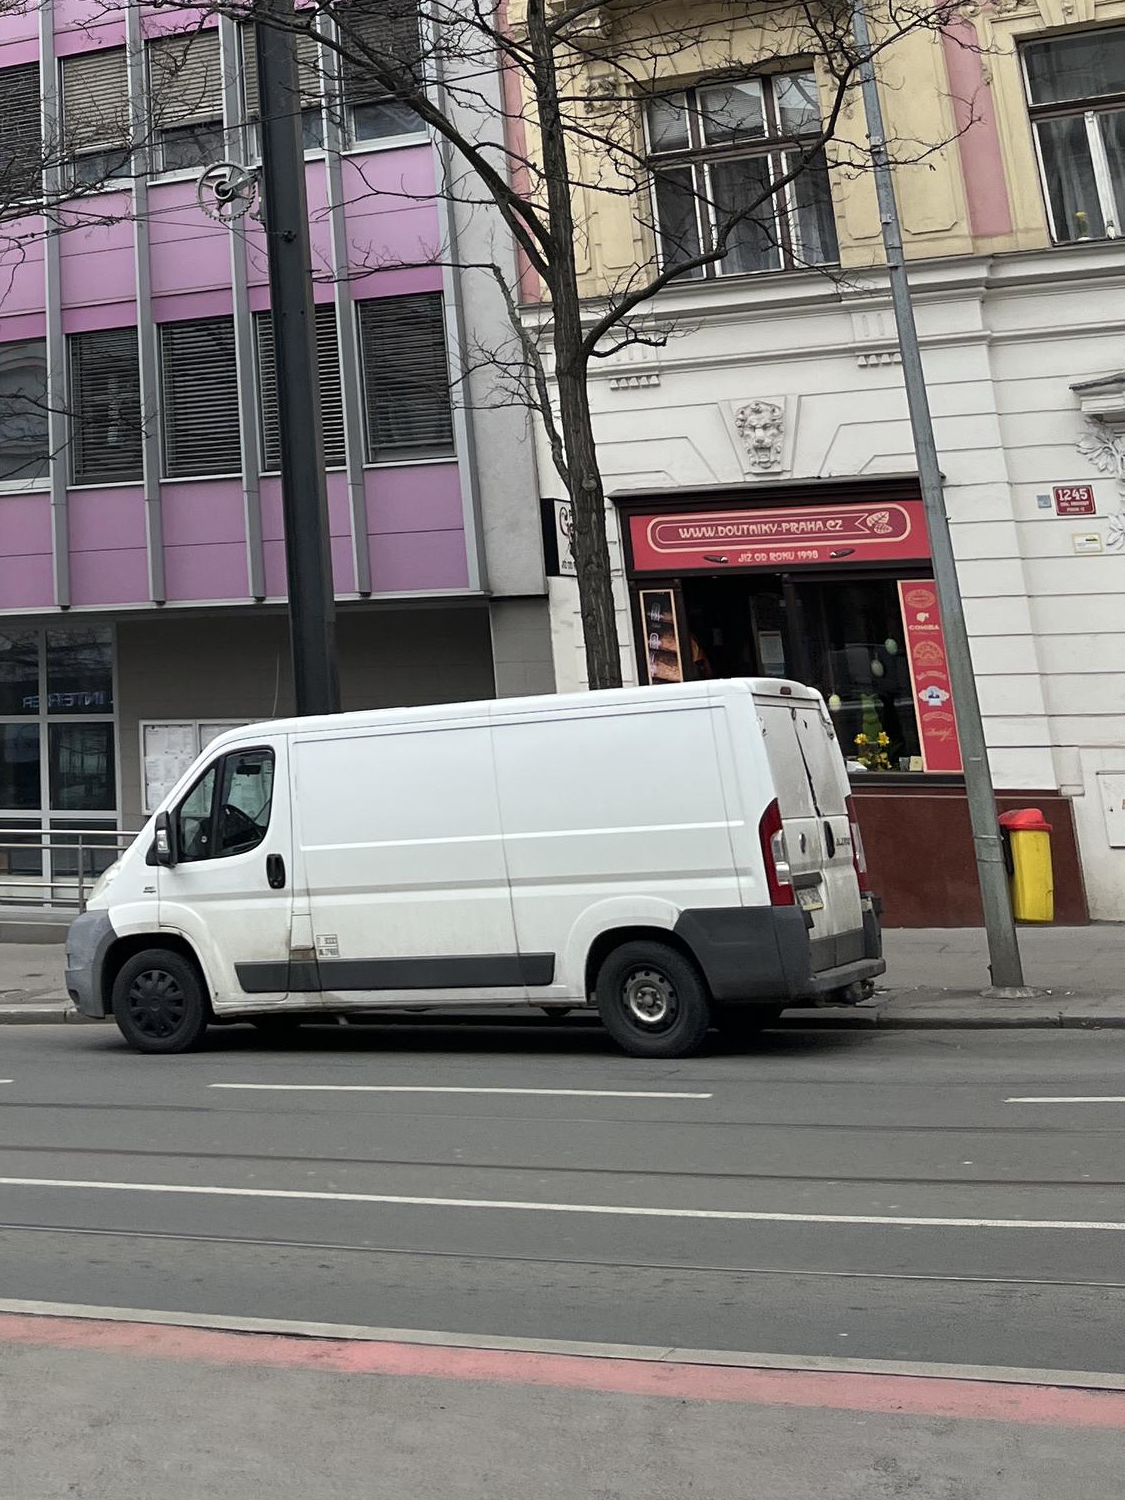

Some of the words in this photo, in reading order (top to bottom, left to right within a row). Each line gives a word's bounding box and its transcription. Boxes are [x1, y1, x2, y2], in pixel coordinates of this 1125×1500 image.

[1057, 488, 1088, 501] 1245
[754, 552, 767, 562] OD
[769, 551, 795, 562] ROKU
